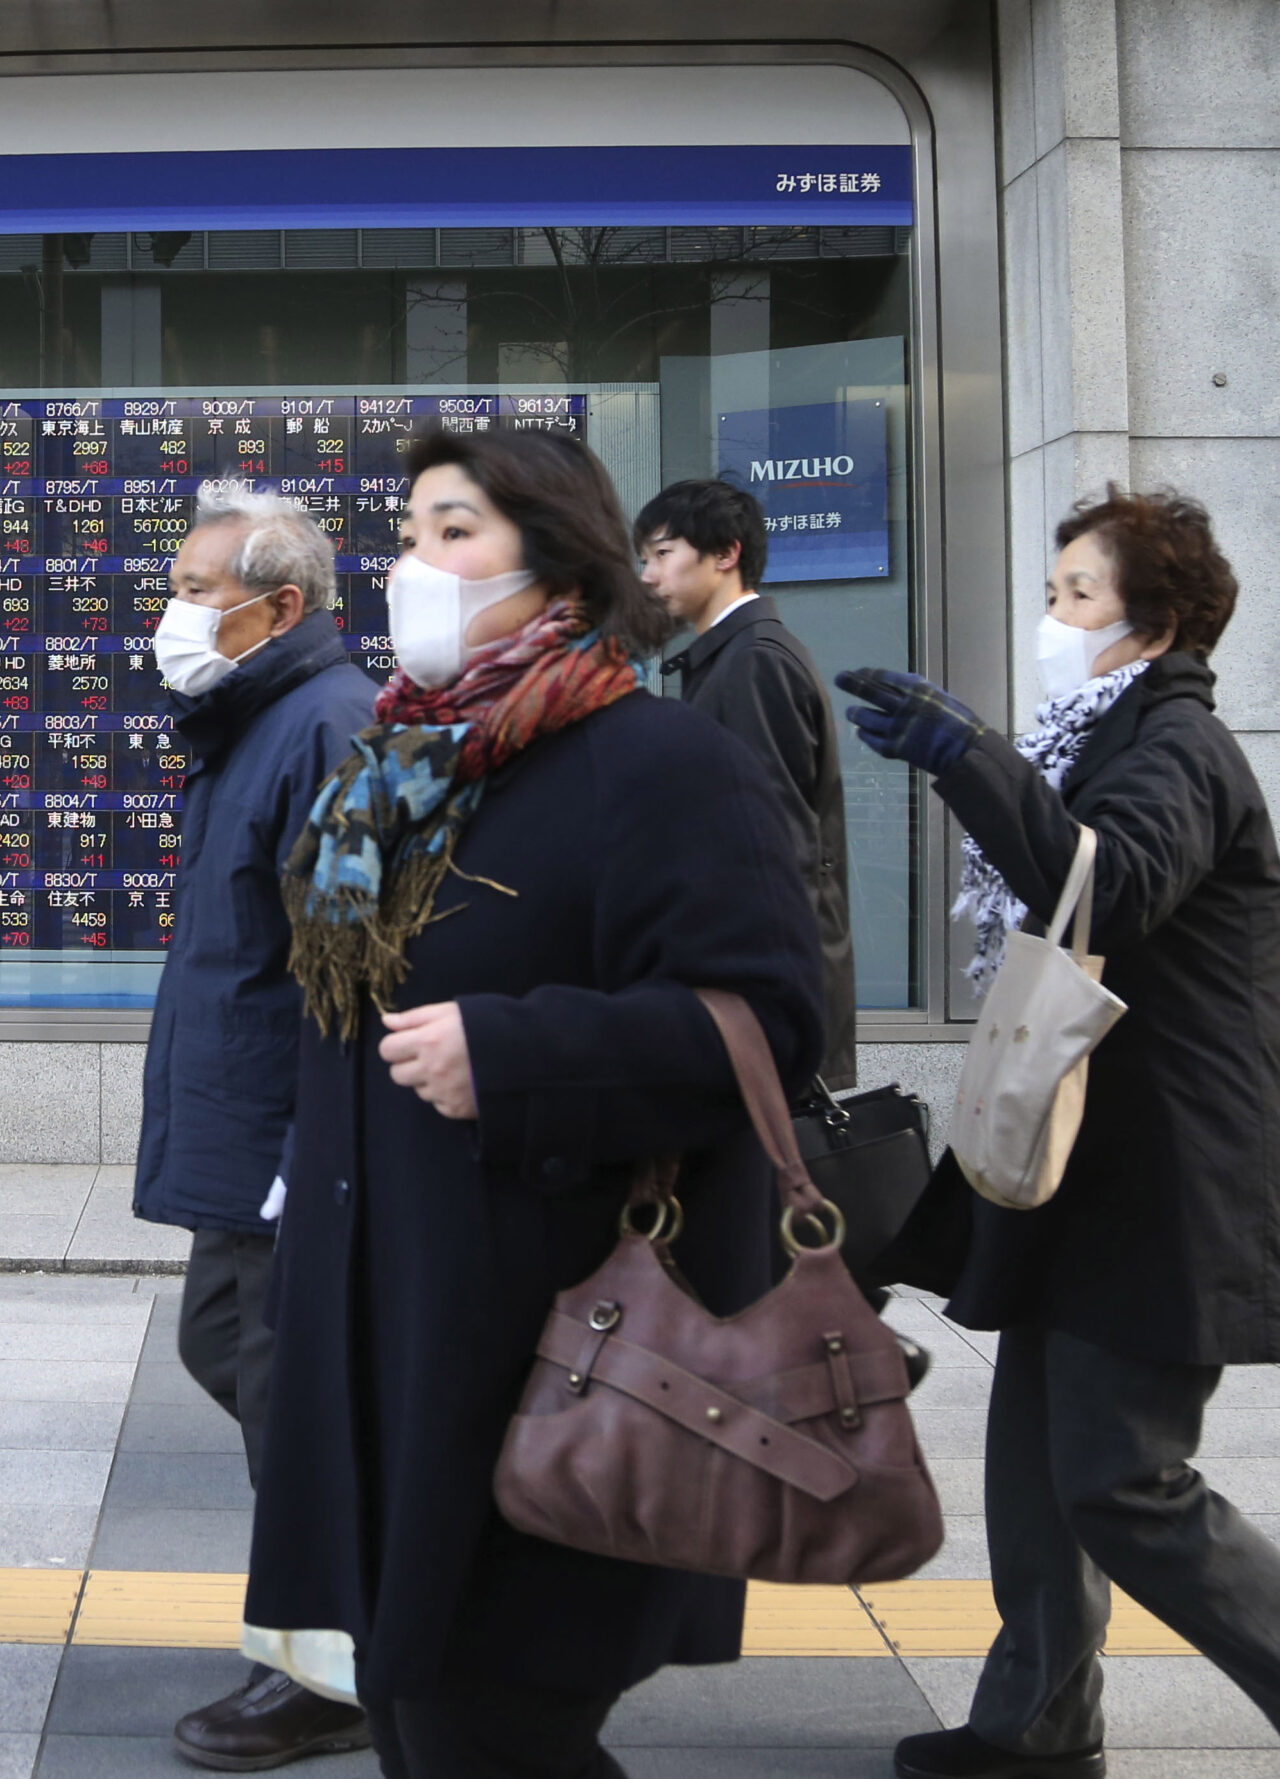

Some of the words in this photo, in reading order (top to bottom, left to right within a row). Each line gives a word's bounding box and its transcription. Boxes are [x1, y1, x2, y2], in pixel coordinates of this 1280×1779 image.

[775, 172, 881, 193] みずほ証券
[47, 401, 101, 416] 8766/T
[125, 401, 177, 415] 8929/T
[282, 400, 334, 414] 9101/T
[360, 399, 413, 413] 9412/T
[519, 398, 571, 412] 9613/T
[42, 420, 104, 435] 東京海上
[120, 419, 183, 435] 青山財産
[74, 441, 107, 455] 2997
[160, 441, 185, 454] 482
[239, 440, 264, 453] 893
[318, 440, 343, 453] 322
[4, 461, 29, 475] +22
[160, 460, 187, 473] +10
[240, 460, 264, 472] +14
[318, 459, 344, 472] +15
[750, 455, 854, 482] MIZUHO
[46, 480, 98, 494] 8795/T
[125, 479, 176, 493] 8951/T
[282, 478, 334, 492] 9104/T
[122, 497, 183, 513] 日本ビルF
[4, 520, 28, 533] 944
[74, 520, 103, 533] 1261
[134, 519, 187, 532] 567000
[316, 518, 343, 533] 407
[765, 512, 842, 531] みずほ証券
[46, 558, 98, 572] 8801/T
[49, 576, 96, 591] 三井不
[3, 598, 28, 611] 693
[73, 598, 108, 611] 3230
[46, 637, 98, 650] 8802/T
[5, 657, 25, 669] HD
[49, 654, 95, 670] 菱地所
[73, 677, 108, 689] 2570
[45, 715, 98, 729] 8803/T
[48, 733, 95, 748] 平和不
[73, 755, 106, 768] 1558
[160, 755, 185, 769] 625
[45, 794, 97, 808] 8804/T
[124, 794, 176, 808] 9007/T
[48, 812, 95, 828] 東建物
[126, 812, 174, 828] 小田急
[81, 834, 106, 847] 917
[159, 834, 181, 847] 891
[45, 873, 97, 887] 8830/T
[48, 891, 94, 906] 住友不
[72, 913, 106, 926] 4459
